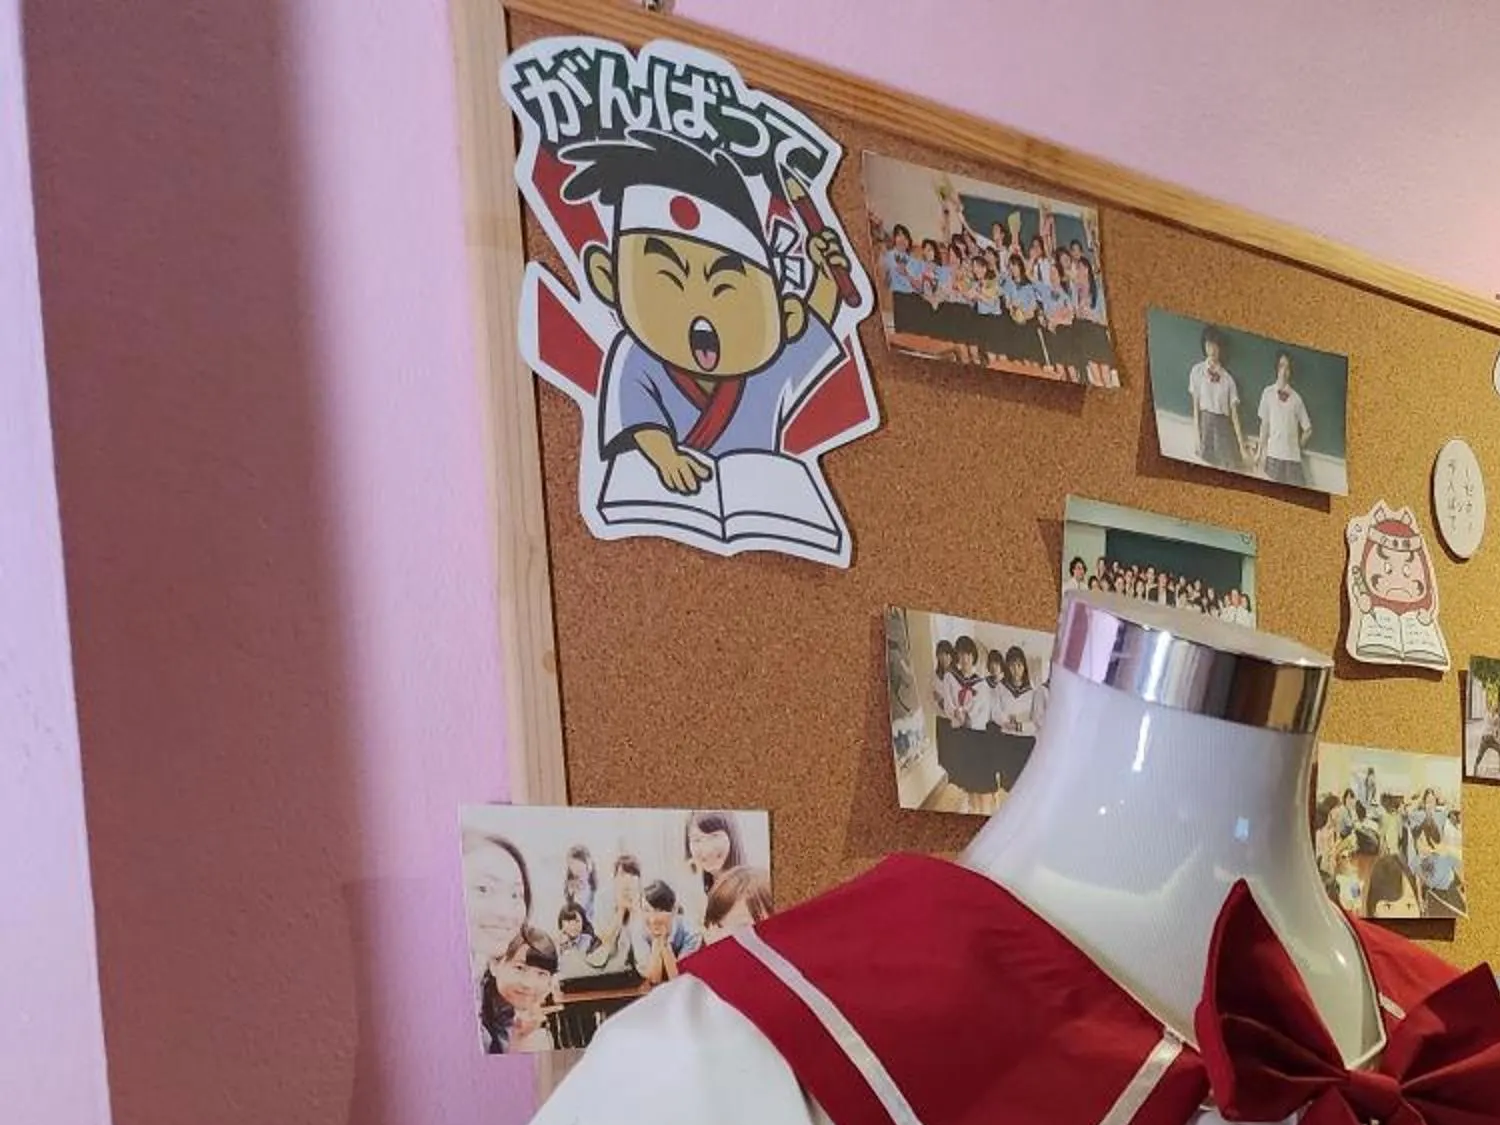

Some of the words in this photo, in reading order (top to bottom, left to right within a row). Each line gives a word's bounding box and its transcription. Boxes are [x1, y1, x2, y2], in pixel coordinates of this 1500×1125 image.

[514, 49, 827, 182] がんばって
